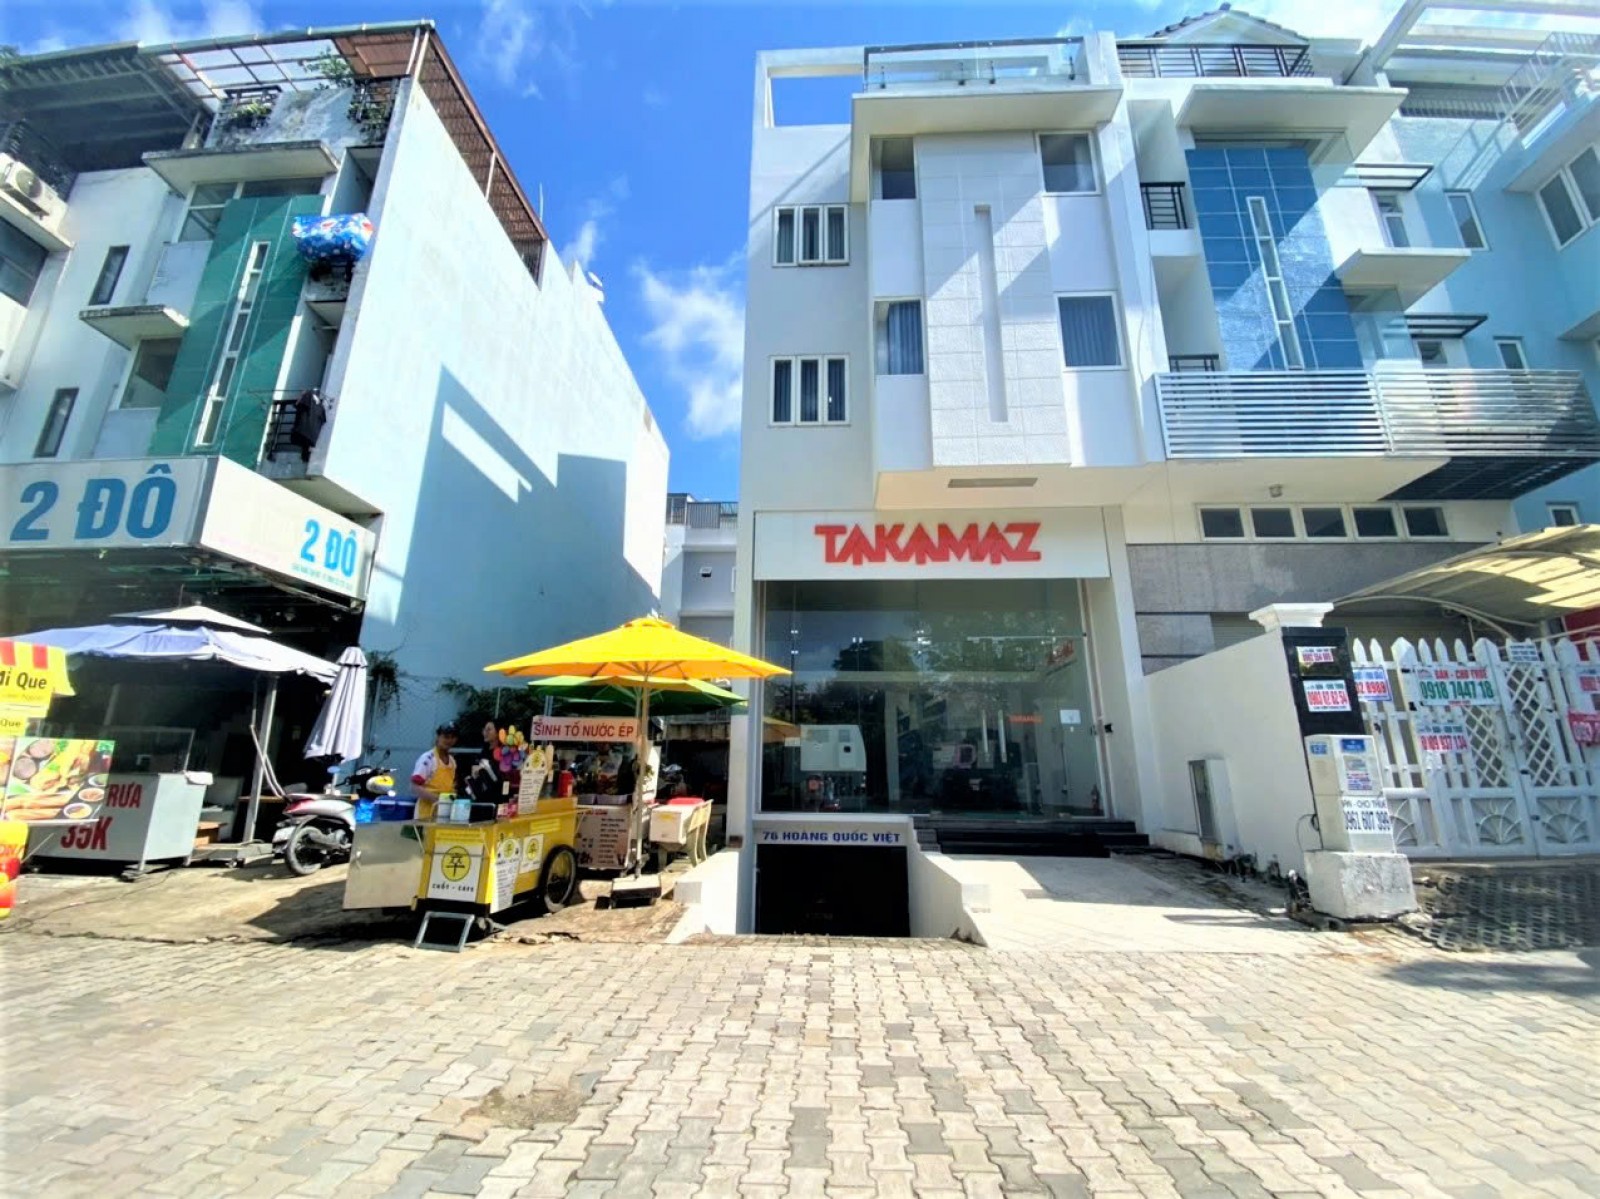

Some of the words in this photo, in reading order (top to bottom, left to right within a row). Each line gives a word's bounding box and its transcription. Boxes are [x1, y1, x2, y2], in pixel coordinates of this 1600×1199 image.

[10, 480, 59, 541] 2
[75, 463, 177, 539] ĐÔ
[300, 519, 320, 562] 2
[324, 529, 357, 577] ĐÔ
[814, 521, 1042, 566] TAKAMAZ
[16, 671, 48, 691] Que
[1420, 680, 1449, 700] 0918
[1477, 680, 1495, 699] 18
[534, 724, 561, 736] SINH
[565, 720, 580, 737] TỐ
[618, 721, 634, 738] ÉP
[762, 830, 779, 841] 76
[782, 829, 828, 842] HOÀNG
[832, 828, 868, 843] QUỐC
[873, 830, 901, 844] VIỆT
